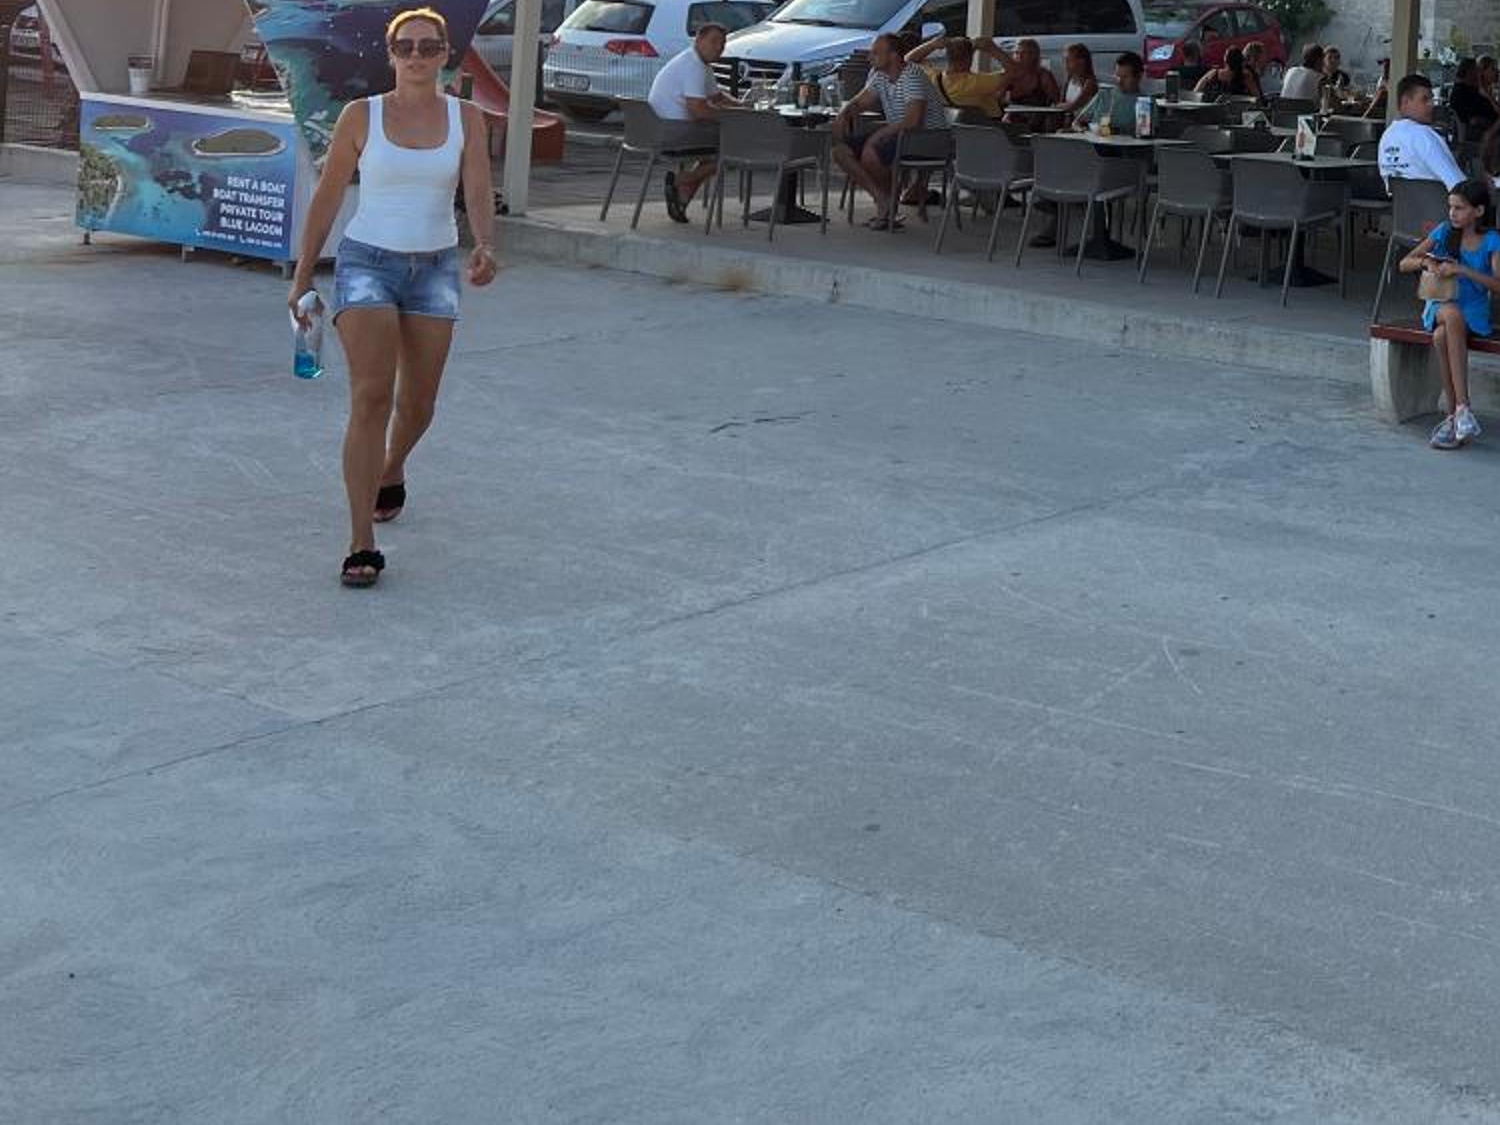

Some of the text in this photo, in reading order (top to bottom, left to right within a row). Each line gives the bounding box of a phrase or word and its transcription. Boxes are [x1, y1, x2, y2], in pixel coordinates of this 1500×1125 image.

[227, 176, 287, 194] RENT A BOAT
[213, 187, 285, 208] BOAT TRANSFER
[220, 202, 284, 223] PRIVATE TOUR
[220, 216, 243, 230] BLUE
[245, 221, 283, 236] LAGOON
